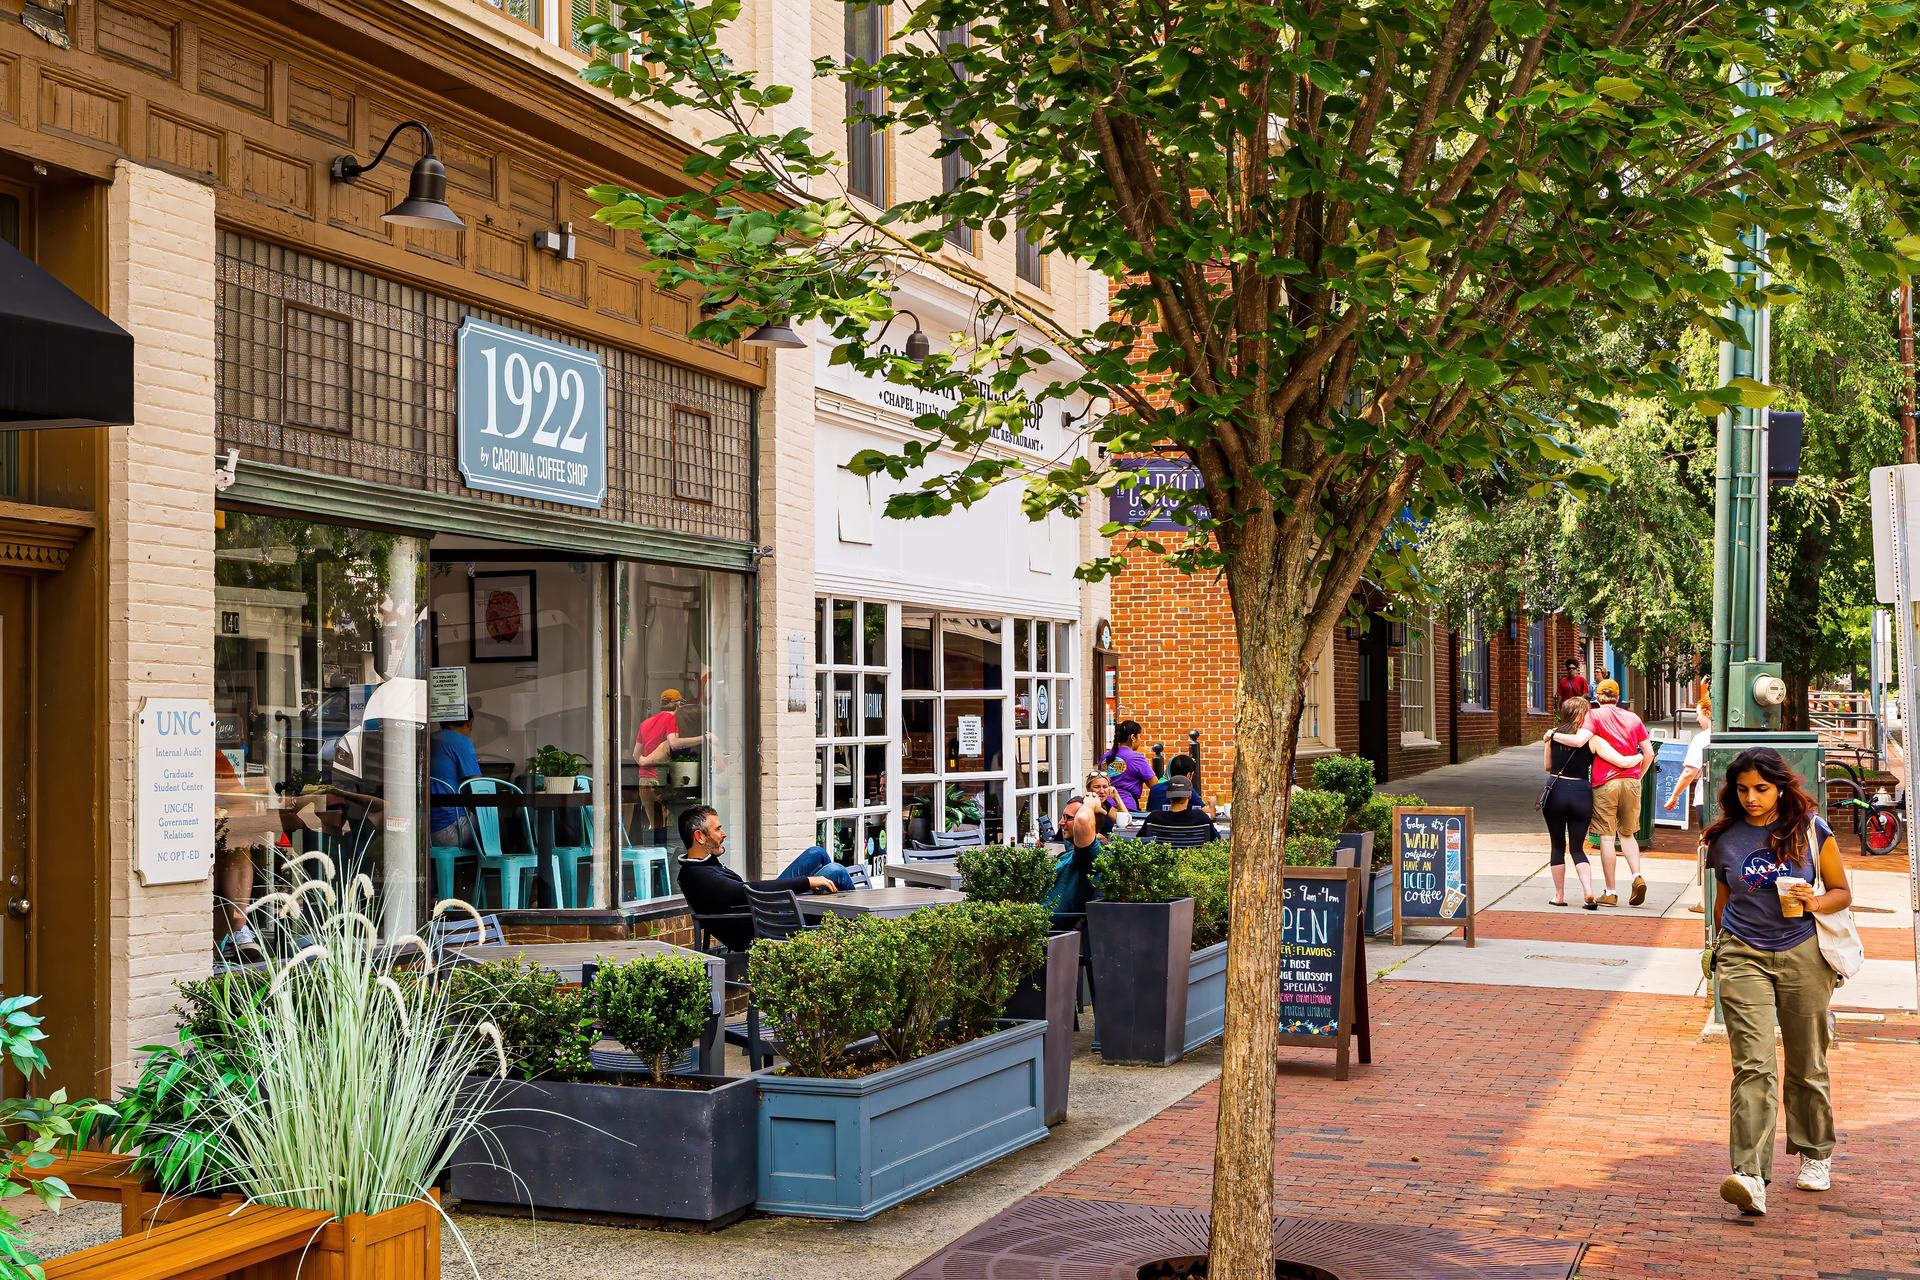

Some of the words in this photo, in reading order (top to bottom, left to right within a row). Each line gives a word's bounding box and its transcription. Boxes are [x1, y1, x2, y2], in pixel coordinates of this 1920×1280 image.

[480, 346, 588, 454] 1922
[884, 390, 914, 413] CHAPEL
[480, 447, 489, 467] by
[492, 446, 535, 477] CAROLINA
[537, 455, 566, 483] COFFEE
[567, 462, 588, 487] SHOP
[838, 693, 848, 718] EAT
[865, 693, 883, 719] DRINK
[157, 711, 201, 736] UNC
[155, 747, 182, 757] Internal
[184, 747, 202, 757] Audit
[163, 768, 194, 779] Graduate
[153, 782, 180, 792] Student
[181, 781, 203, 791] Center
[1665, 775, 1674, 801] Cente
[164, 803, 194, 814] UNC-CH
[158, 817, 199, 827] Government
[1405, 816, 1427, 834] baby
[1431, 818, 1444, 831] it's
[163, 830, 194, 840] Relations
[1403, 832, 1439, 850] WARM
[157, 852, 169, 862] NC
[170, 851, 185, 861] OPT
[1403, 861, 1419, 871] HAVE
[1422, 861, 1432, 871] AN
[1744, 862, 1789, 876] NASA
[1404, 889, 1443, 904] coffee
[1281, 905, 1328, 944] PEN
[1296, 945, 1336, 957] FLAVORS:
[1289, 959, 1311, 969] ROSE
[1296, 971, 1333, 982] BLOSSOM
[1283, 982, 1327, 993] SPECIALS:
